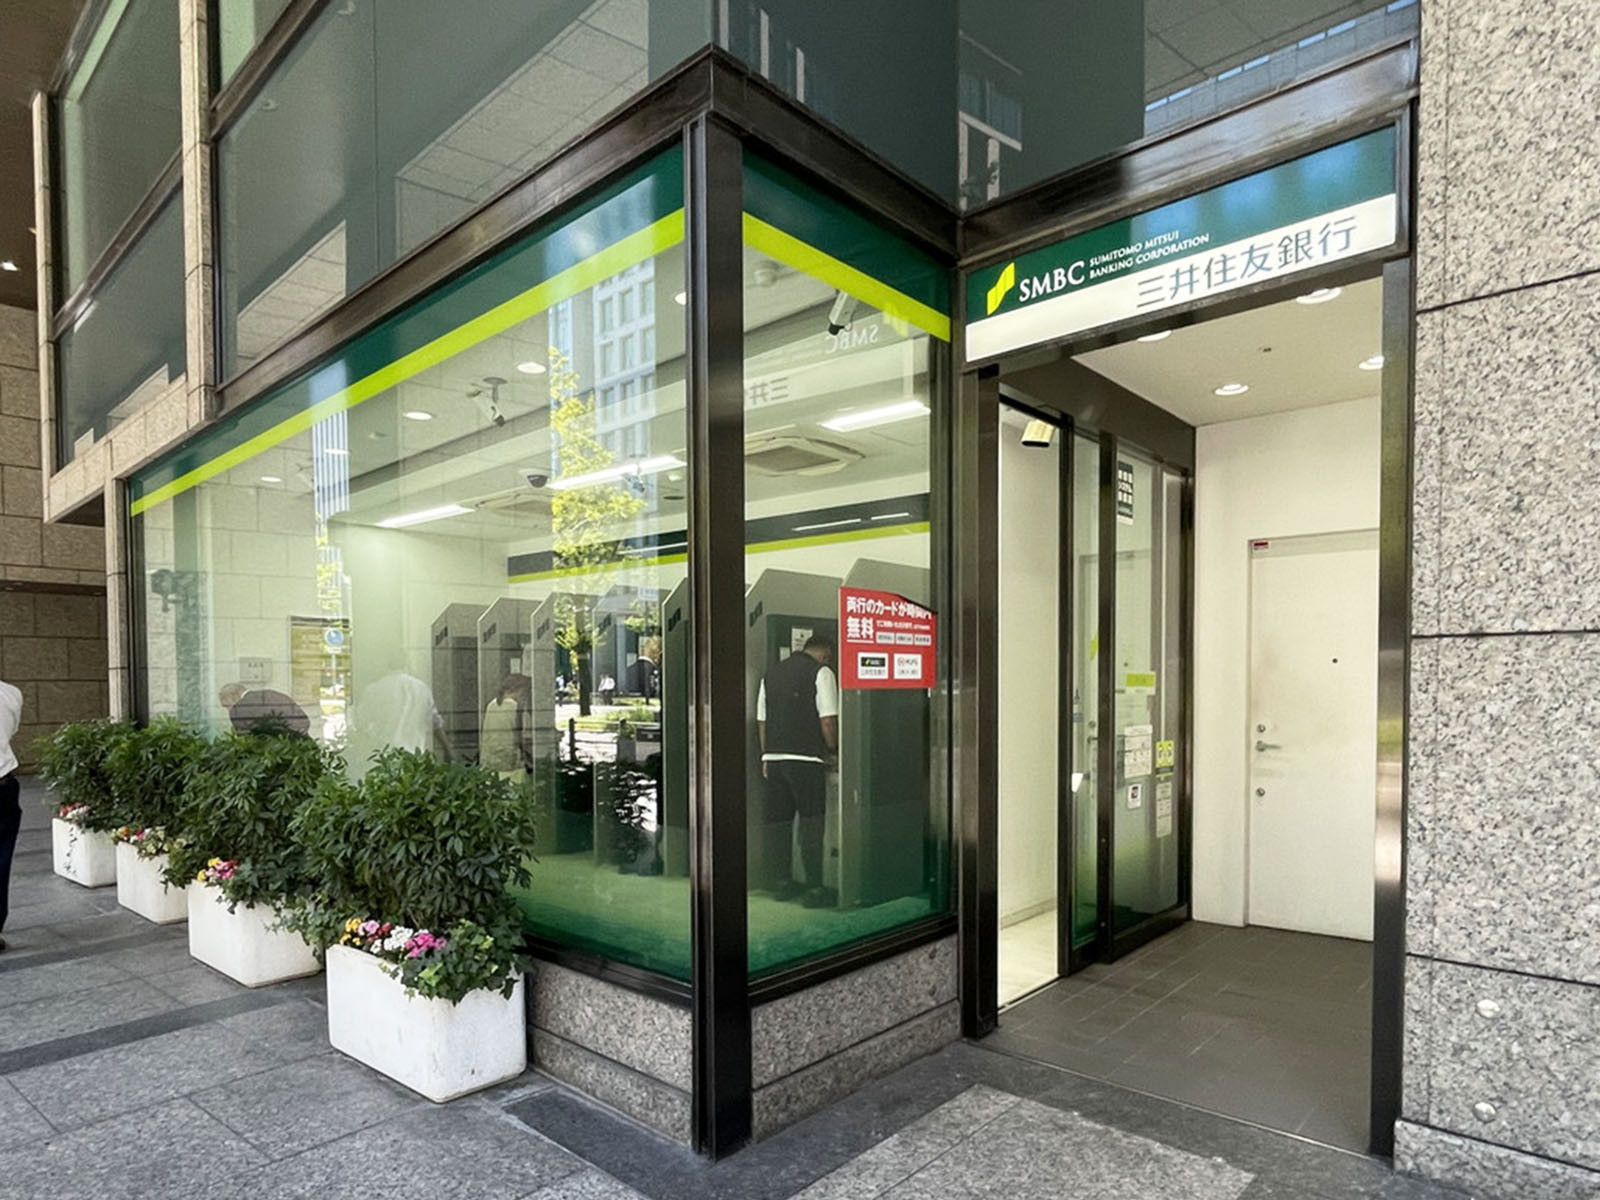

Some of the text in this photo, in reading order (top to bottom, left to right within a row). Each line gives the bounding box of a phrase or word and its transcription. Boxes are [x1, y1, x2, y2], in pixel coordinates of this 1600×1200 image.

[1089, 231, 1179, 267] SUMITOMO MITSUI
[1089, 233, 1210, 280] BANKING CORPORATION
[1136, 215, 1358, 308] 三井住友銀行
[1018, 260, 1085, 302] SMBC
[846, 616, 875, 639] 無料
